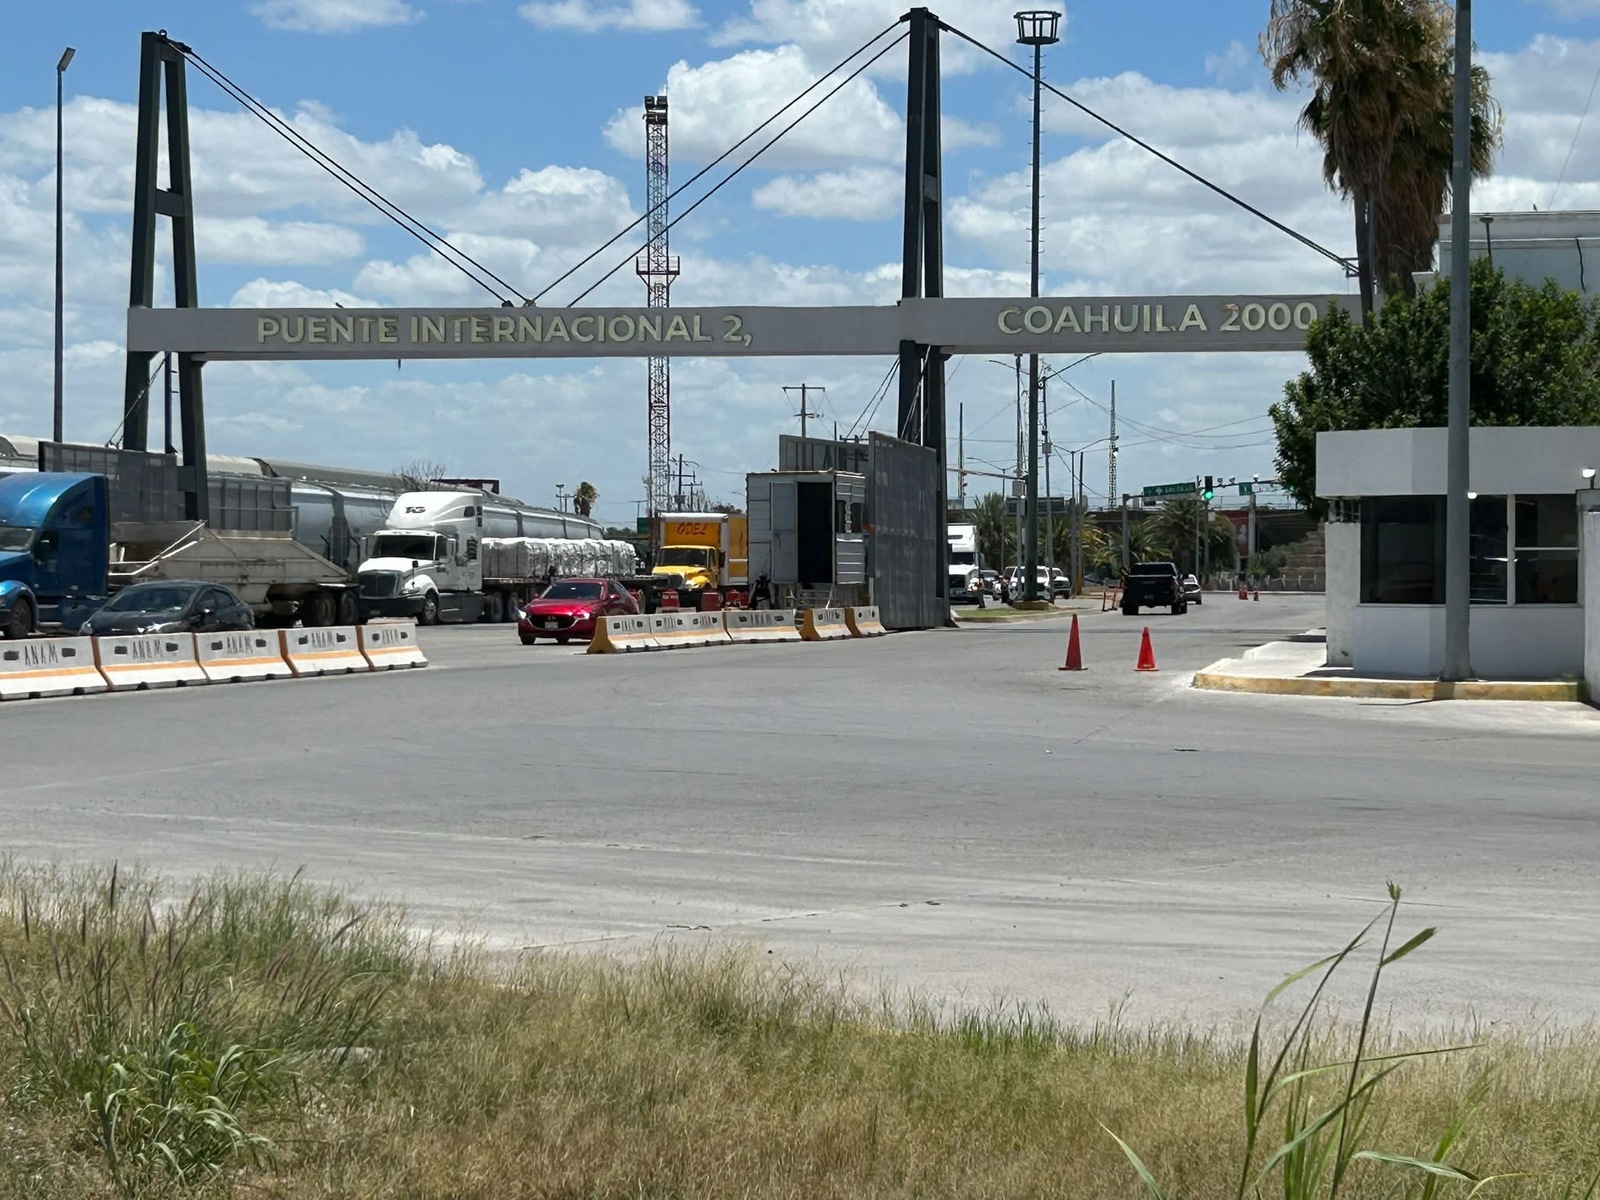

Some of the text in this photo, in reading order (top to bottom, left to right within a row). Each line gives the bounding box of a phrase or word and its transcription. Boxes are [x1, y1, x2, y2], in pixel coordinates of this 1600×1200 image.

[256, 314, 754, 347] PUENTE INTERNACIONAL 2,
[997, 302, 1318, 334] COAHUILA 2000
[24, 644, 59, 666] ANAM
[132, 639, 163, 660] ANAM
